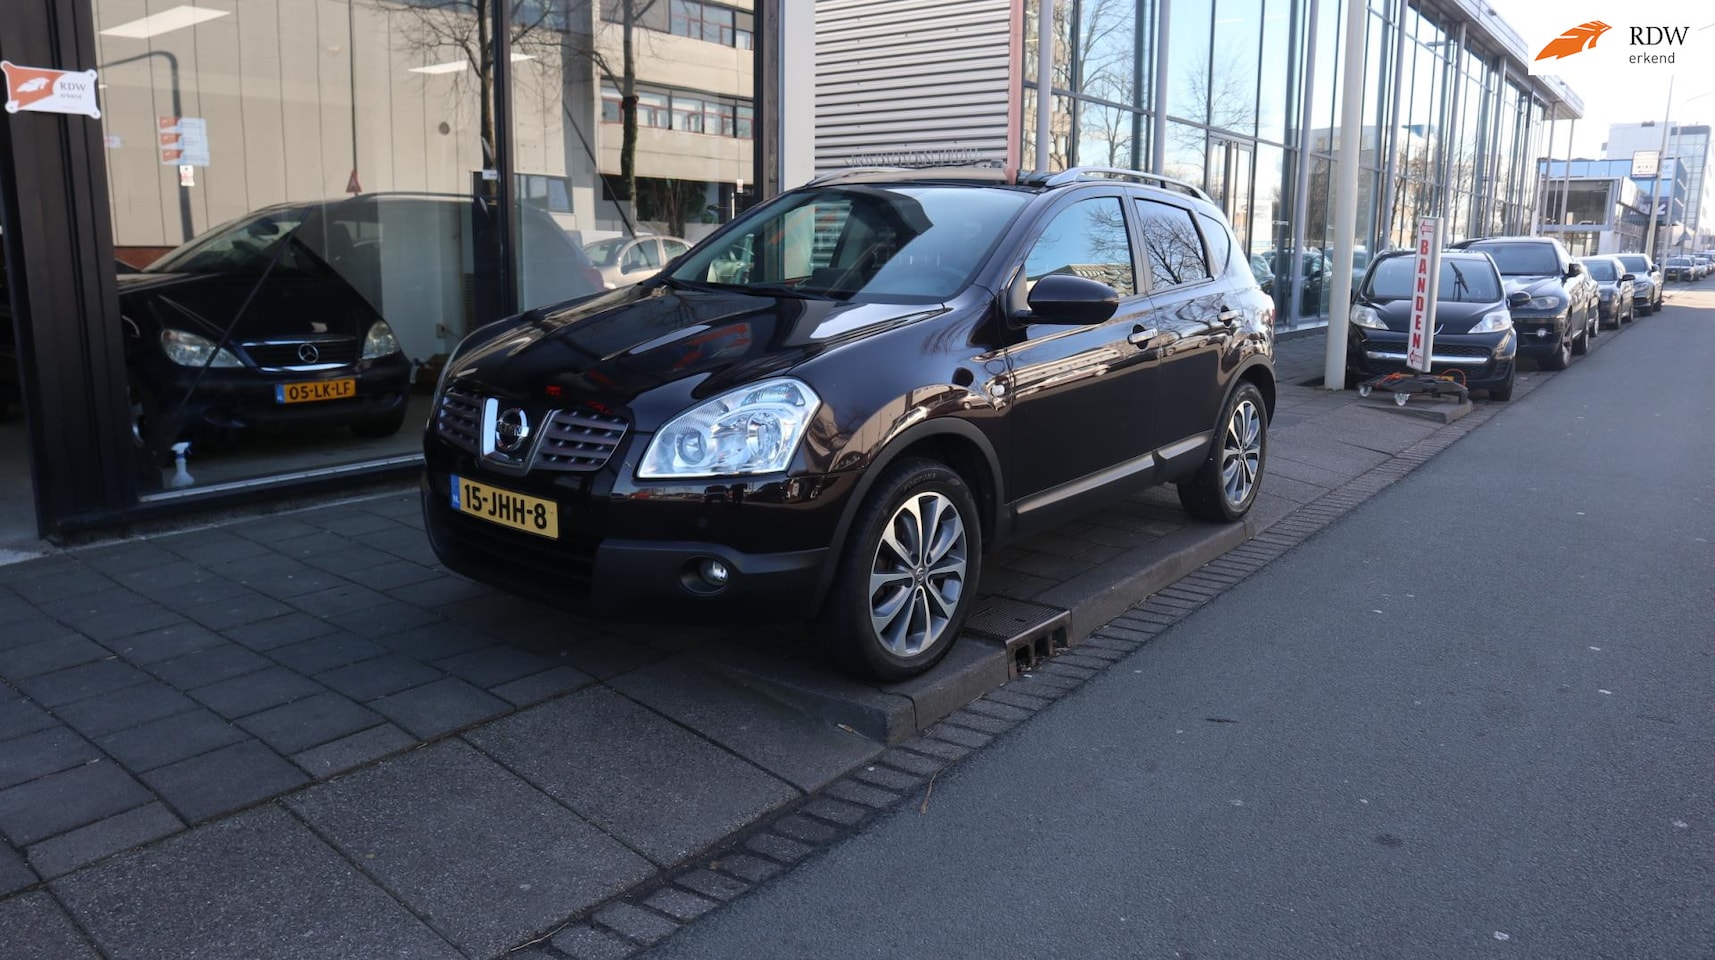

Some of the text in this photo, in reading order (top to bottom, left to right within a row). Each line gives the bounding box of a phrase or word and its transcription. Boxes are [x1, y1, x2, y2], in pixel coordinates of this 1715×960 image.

[60, 81, 86, 92] RDW
[1411, 238, 1429, 349] BANDEN
[289, 381, 350, 400] 05-LK-LF
[464, 484, 547, 530] 15-JHH-8
